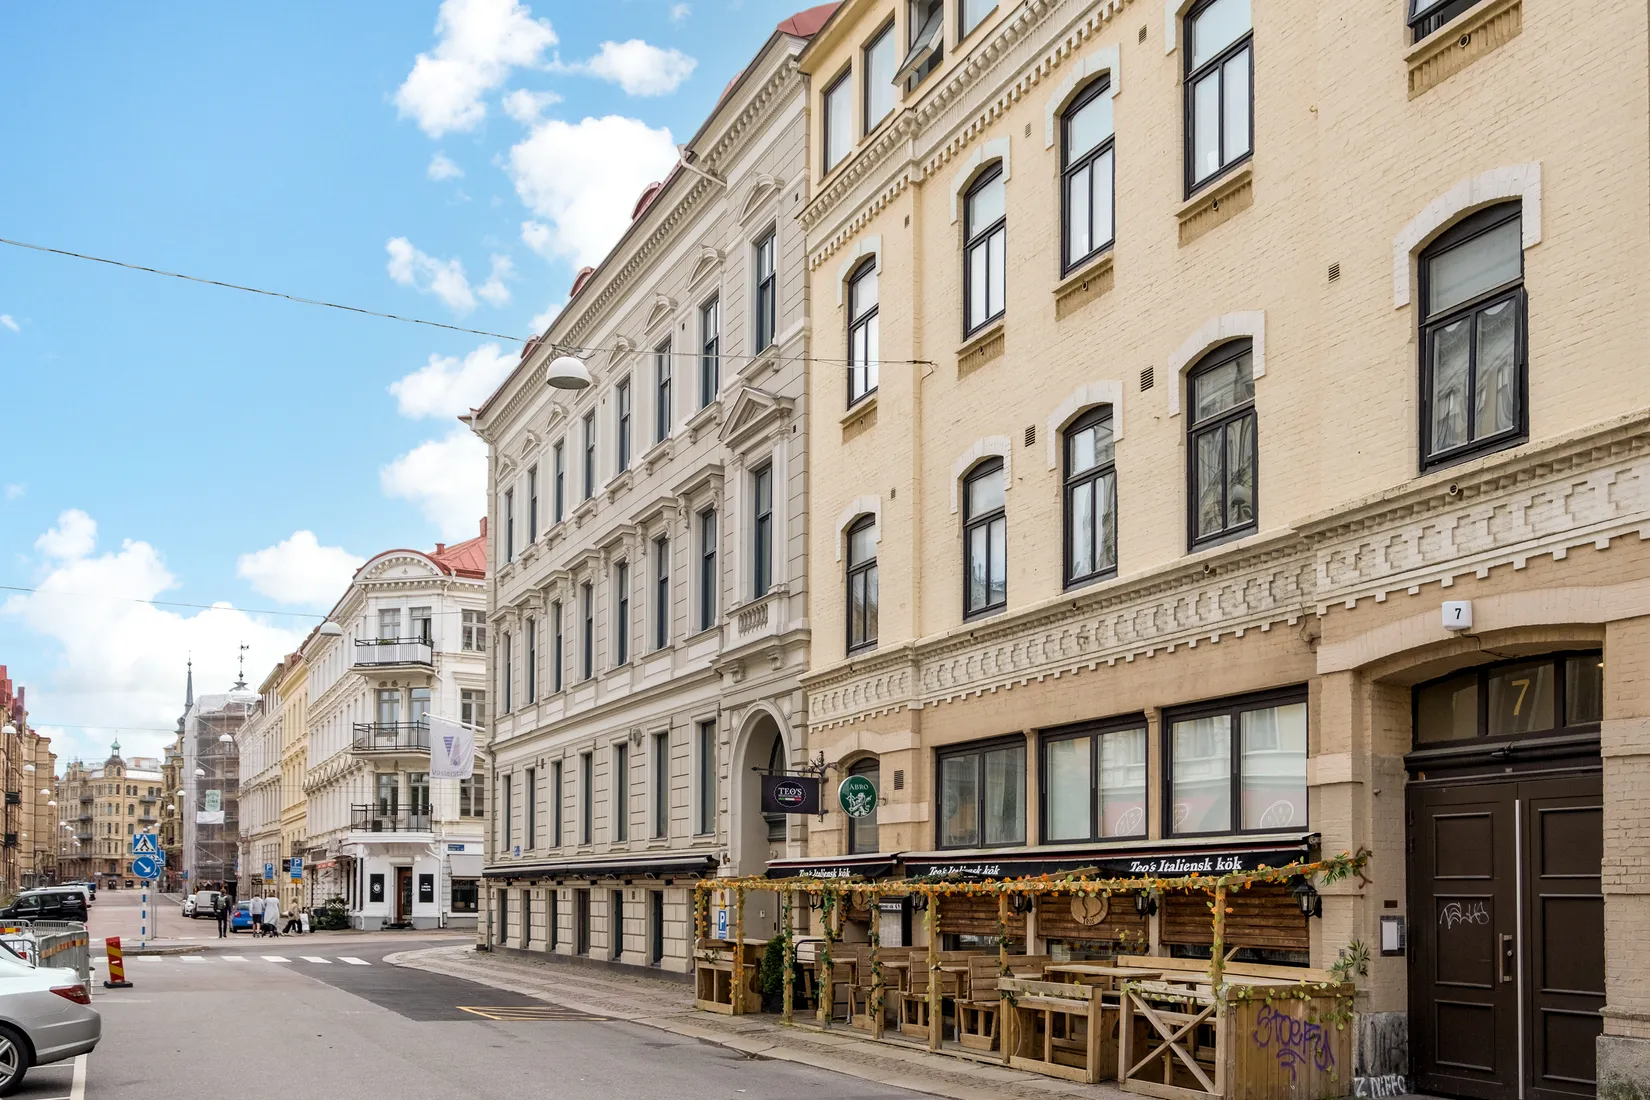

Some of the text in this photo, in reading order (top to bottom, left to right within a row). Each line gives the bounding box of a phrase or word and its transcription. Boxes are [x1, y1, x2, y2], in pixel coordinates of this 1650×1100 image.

[1454, 607, 1462, 620] 7
[1511, 678, 1530, 716] 7
[778, 787, 802, 796] TEO'S
[266, 863, 272, 871] P
[294, 859, 301, 867] P
[1129, 856, 1242, 872] Teo's Italiensk kök
[981, 865, 1001, 875] kök
[719, 912, 725, 930] P
